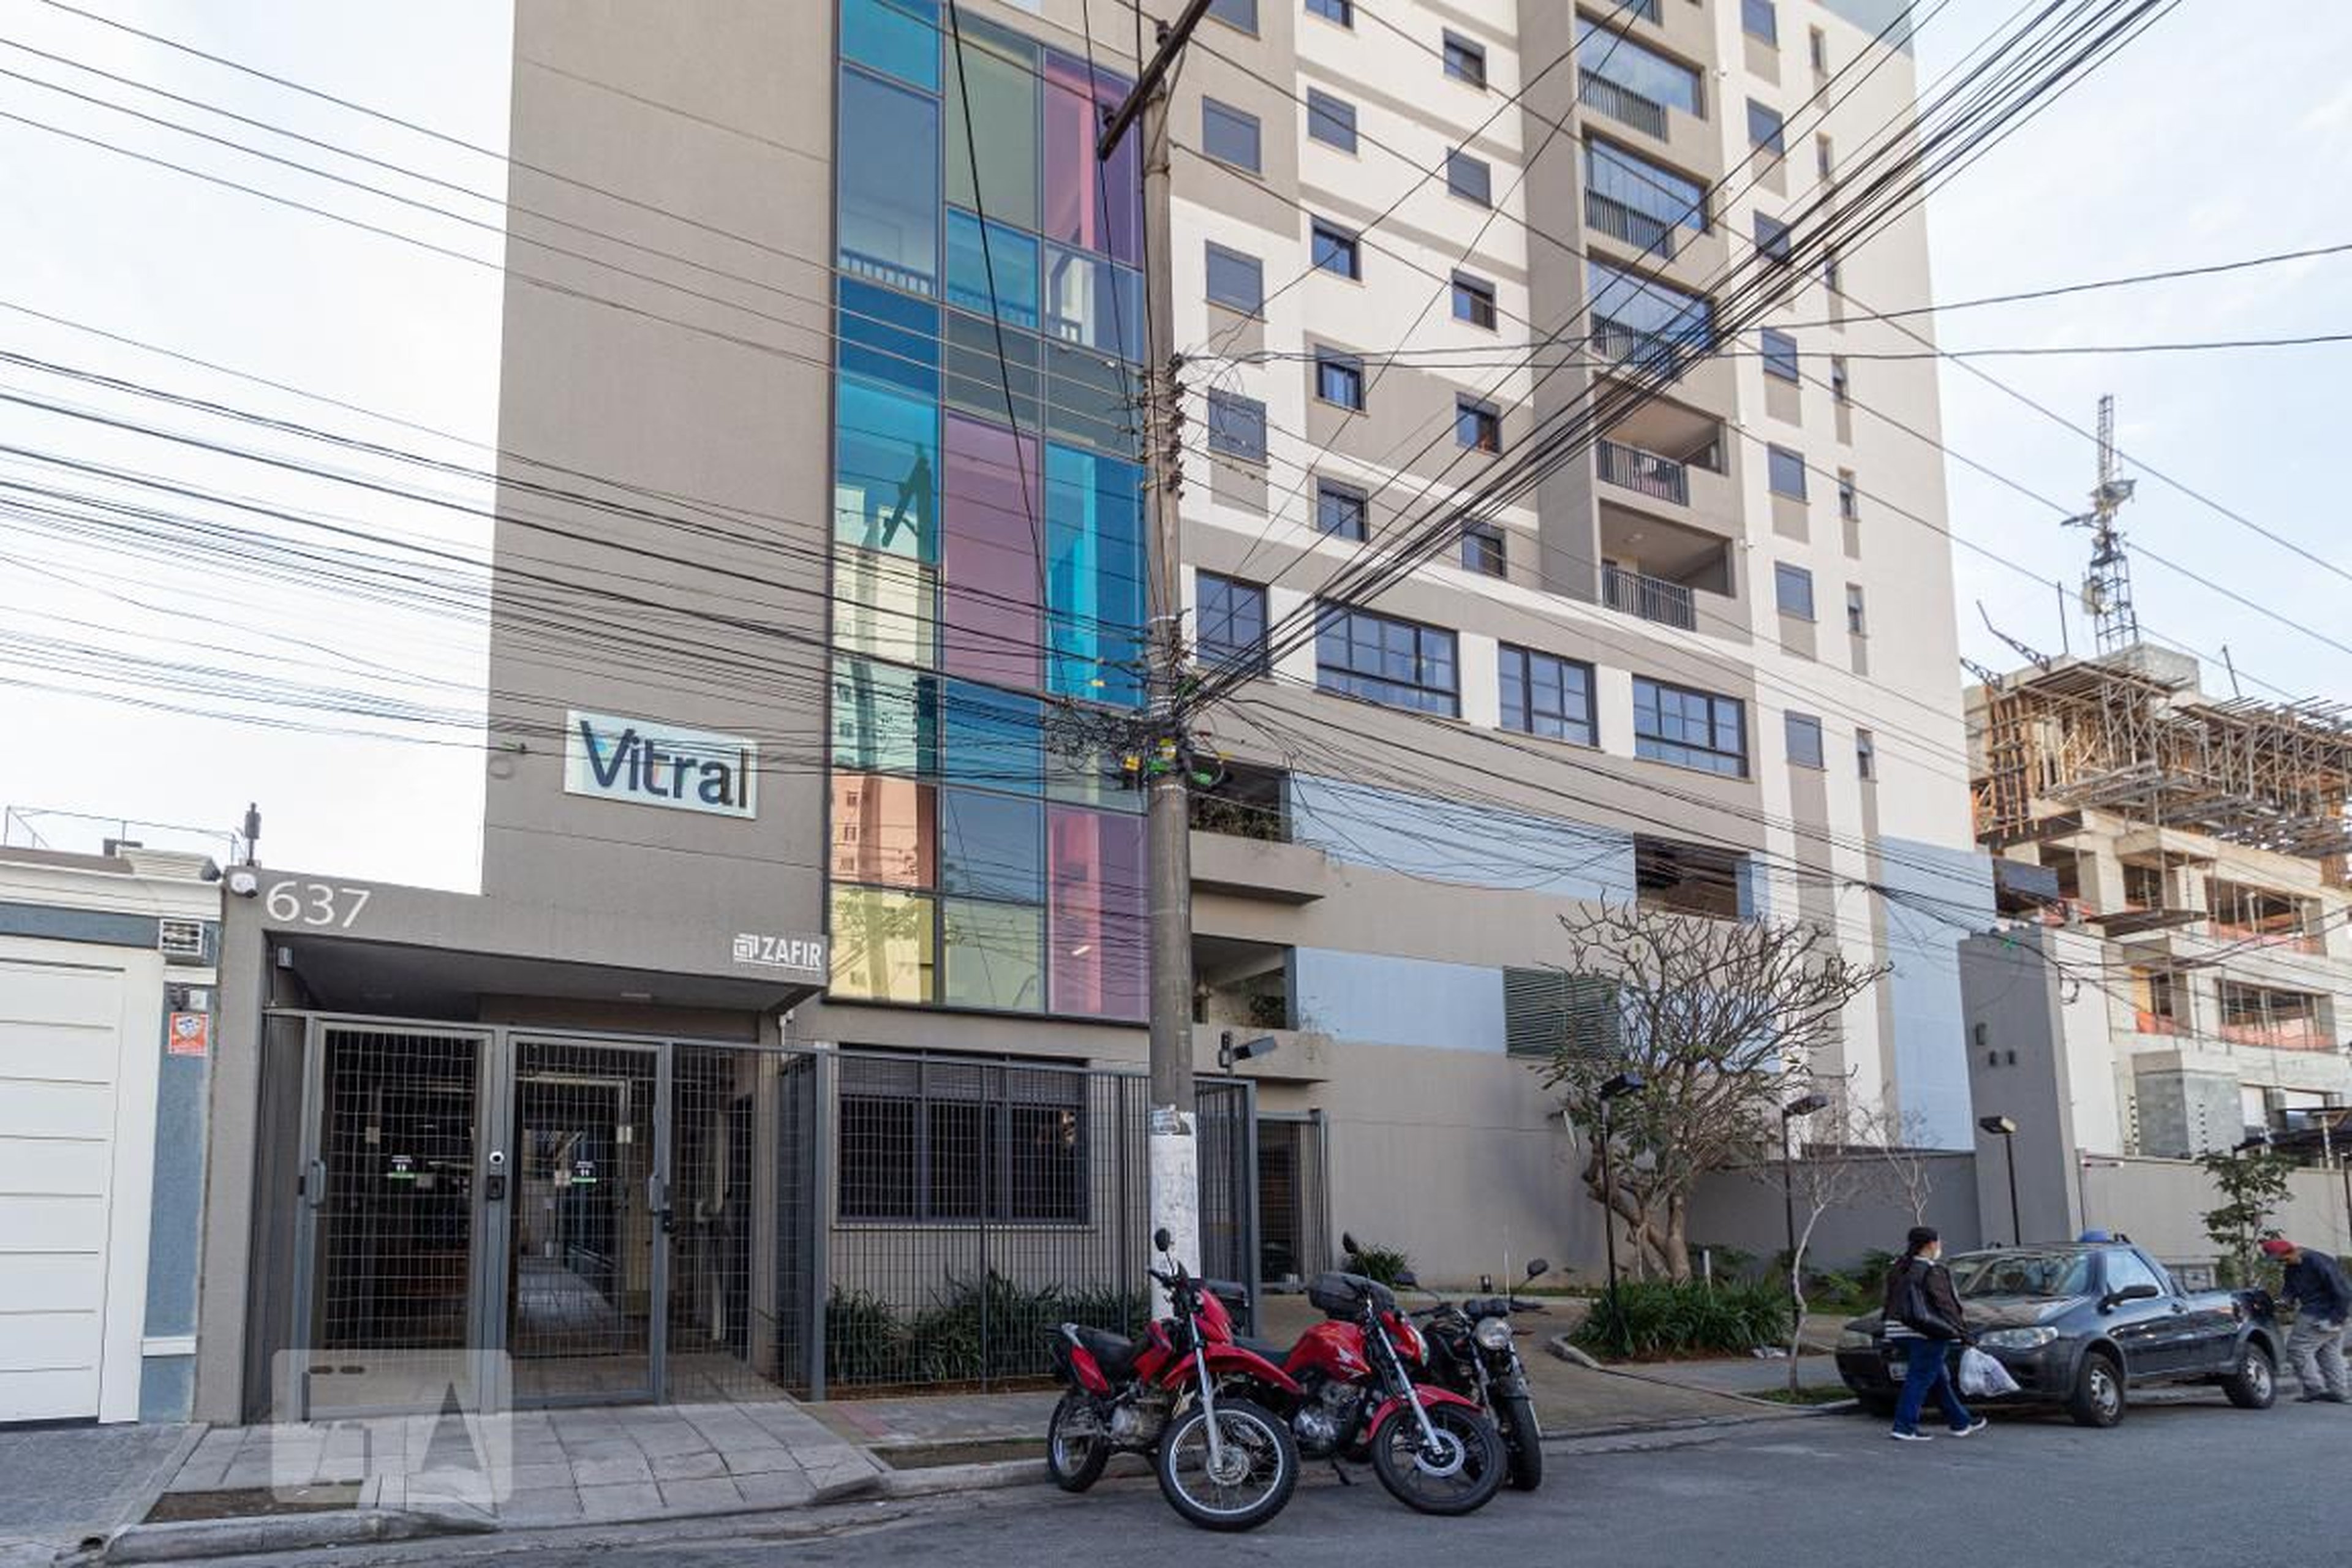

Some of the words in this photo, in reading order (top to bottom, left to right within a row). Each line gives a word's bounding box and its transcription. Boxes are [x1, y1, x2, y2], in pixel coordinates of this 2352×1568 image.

[579, 720, 747, 809] Vitral
[266, 881, 371, 928] 637
[761, 937, 821, 967] ZAFIR
